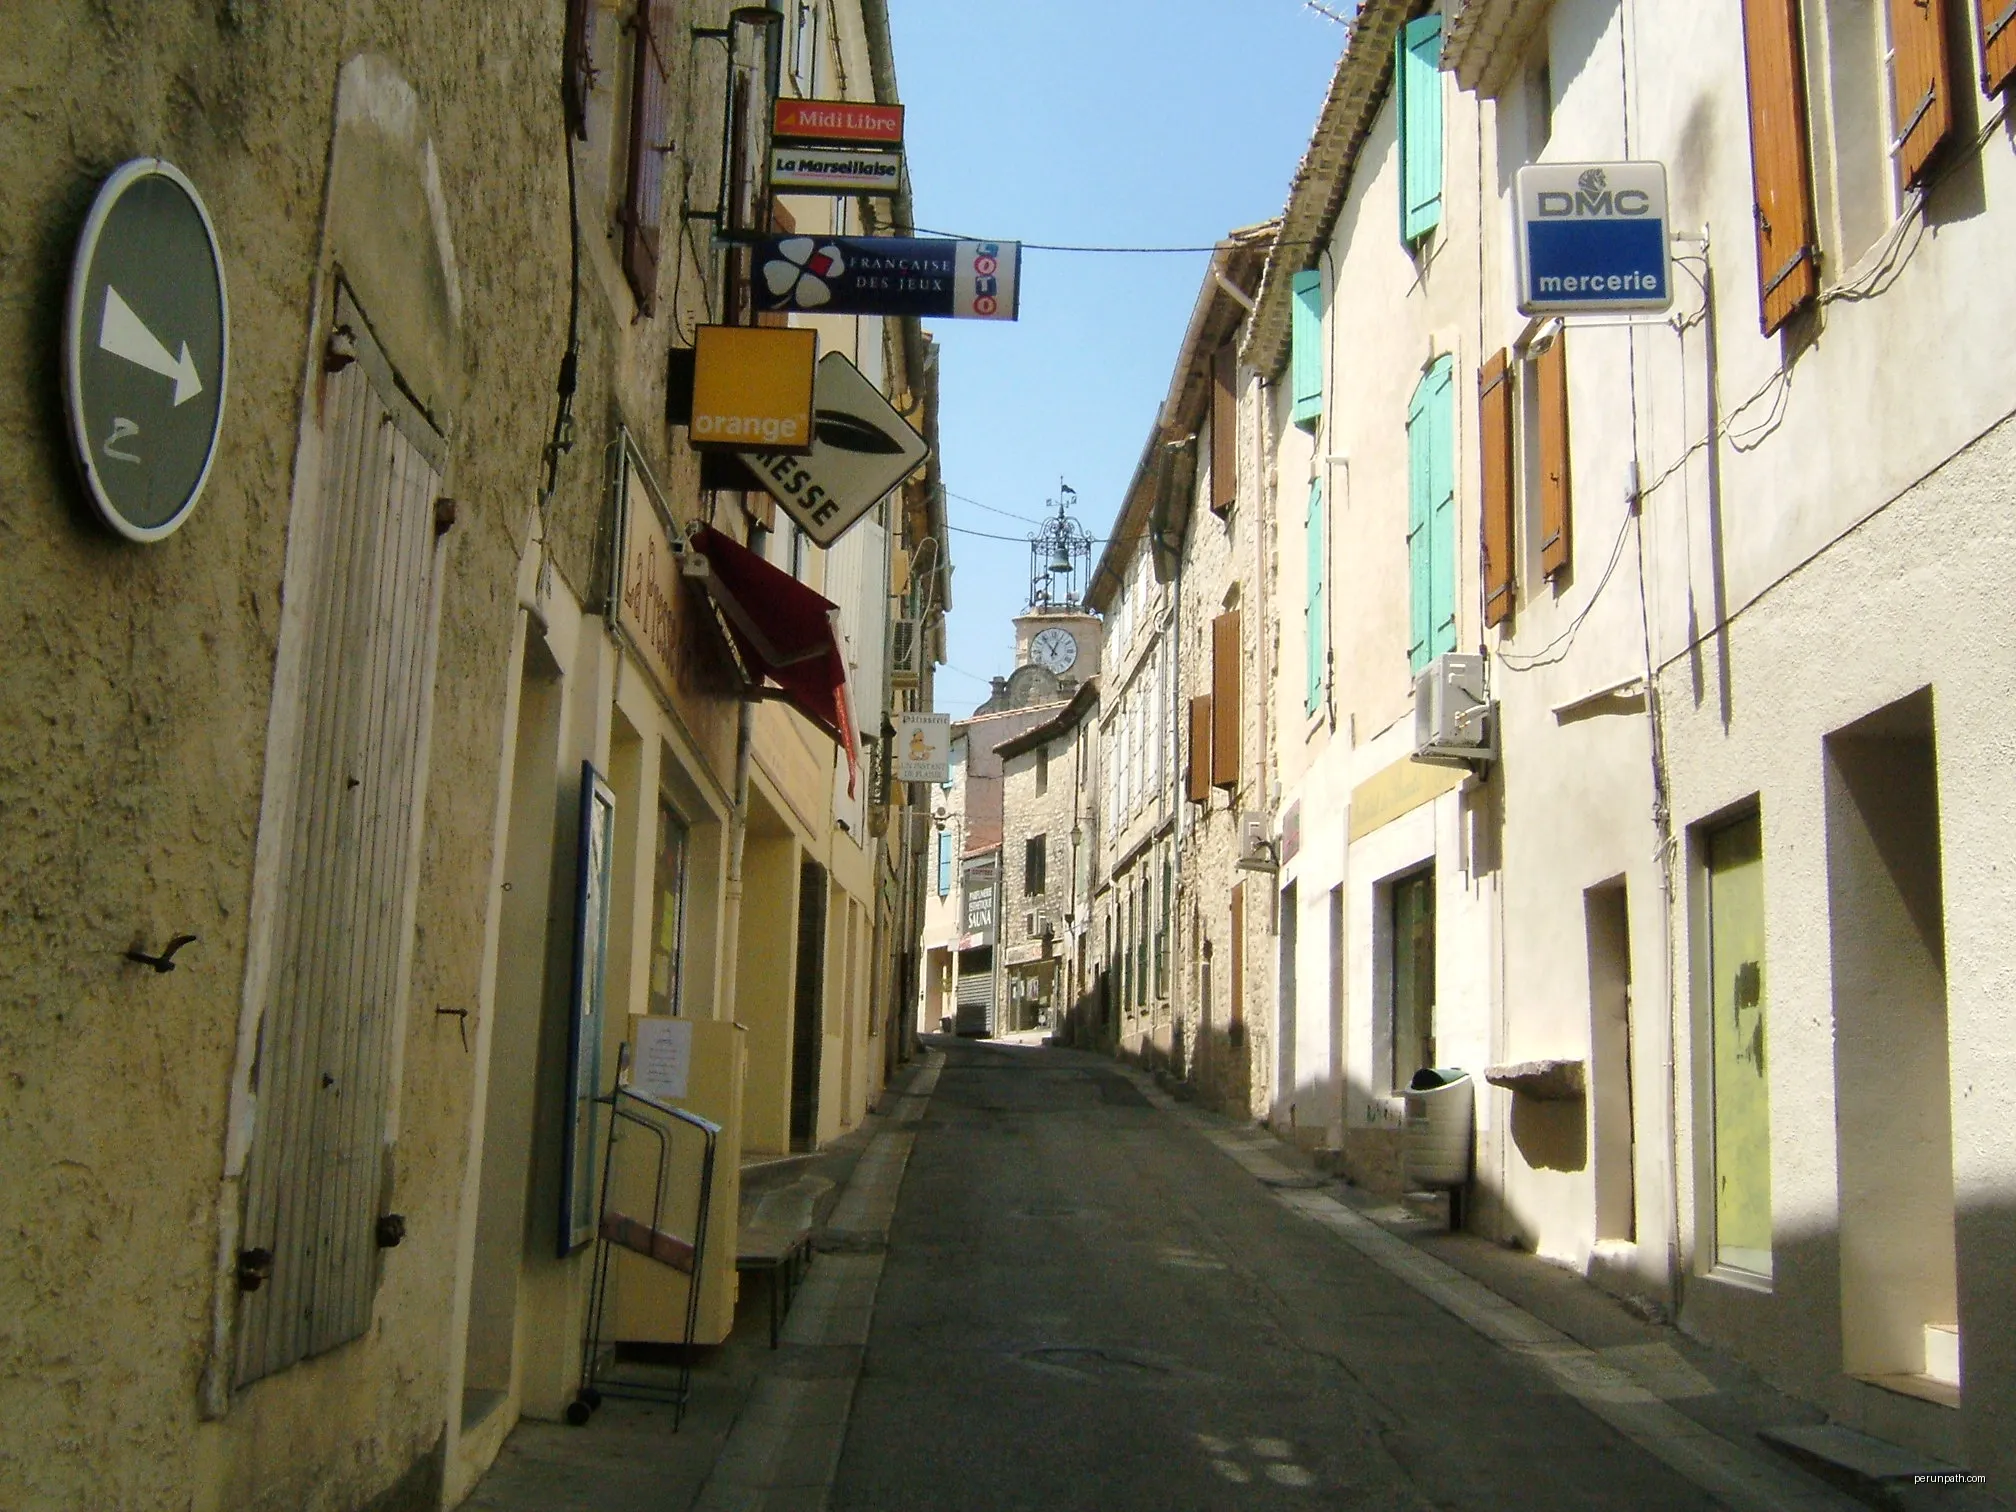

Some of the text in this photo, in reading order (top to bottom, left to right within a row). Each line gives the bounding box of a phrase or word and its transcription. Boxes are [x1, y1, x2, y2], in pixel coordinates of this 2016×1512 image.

[800, 111, 896, 131] Midi Libre
[776, 158, 796, 171] La
[798, 159, 896, 176] Marseillaise
[1537, 190, 1650, 216] DMC
[856, 277, 942, 291] DES JEUX
[1539, 270, 1657, 292] mercerie
[696, 416, 796, 443] orange
[968, 910, 992, 929] SAUNA
